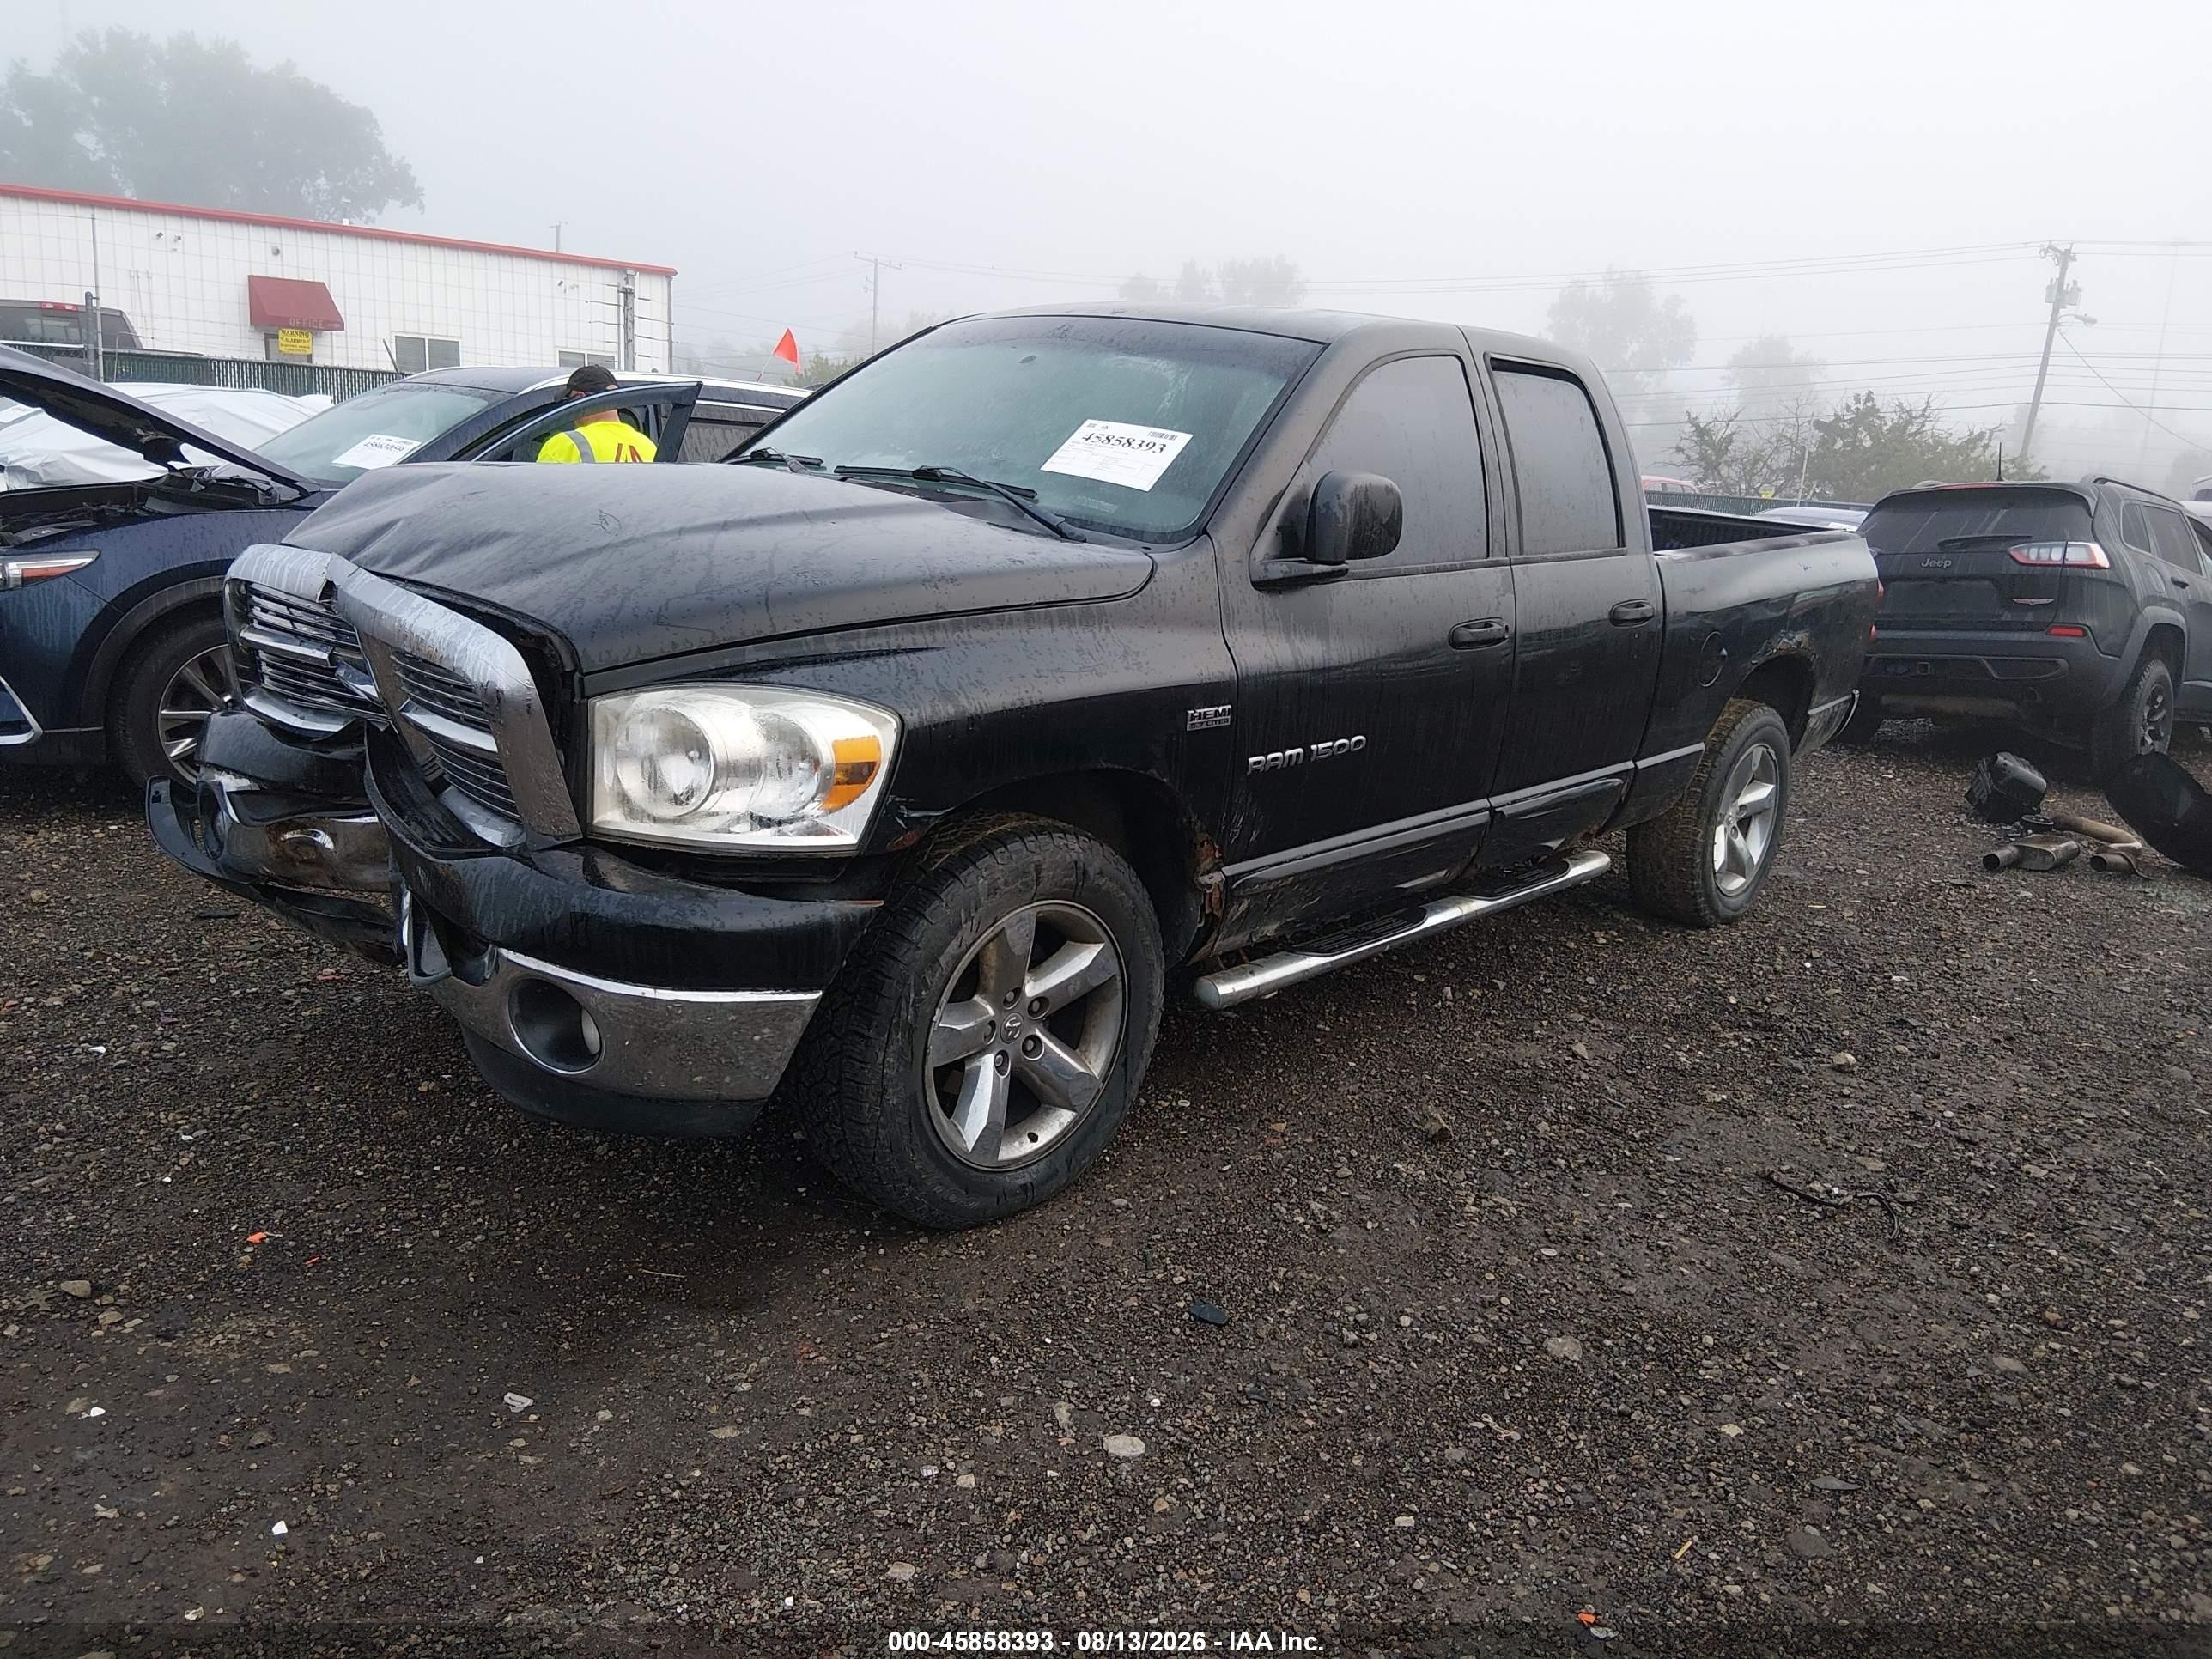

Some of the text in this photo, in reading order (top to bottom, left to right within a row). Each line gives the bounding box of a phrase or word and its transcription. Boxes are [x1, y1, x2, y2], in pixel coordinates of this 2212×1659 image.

[289, 318, 325, 329] OFFICE
[281, 329, 310, 338] WARNING
[1081, 432, 1167, 453] 45858393
[1921, 557, 1952, 568] Jeep
[1189, 707, 1231, 722] HEMI
[1246, 734, 1367, 775] RAM 1500
